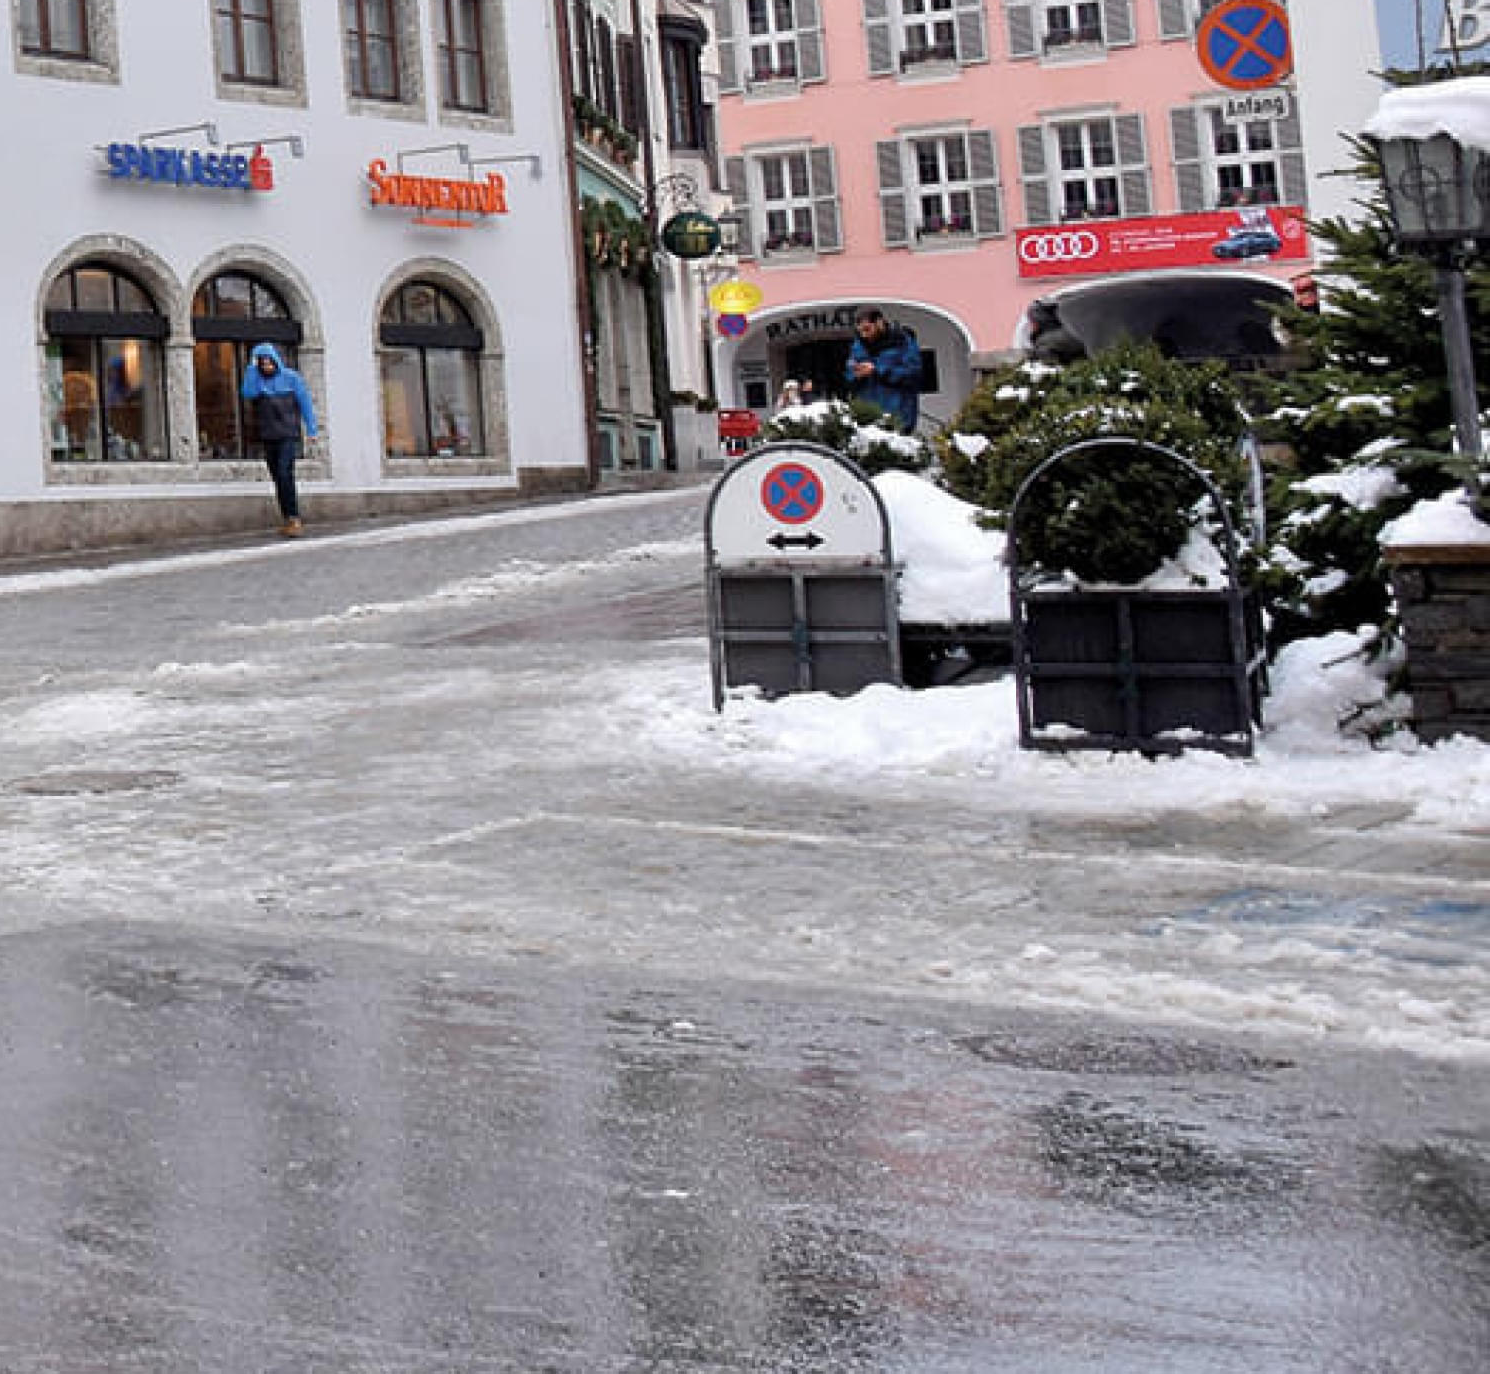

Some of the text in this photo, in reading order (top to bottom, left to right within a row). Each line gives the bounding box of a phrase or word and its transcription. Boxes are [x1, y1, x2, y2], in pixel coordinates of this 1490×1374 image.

[1227, 95, 1286, 118] Anfang
[107, 142, 251, 190] SPARKASSE
[366, 157, 510, 214] SONNENTOR
[765, 305, 859, 339] RATHA
